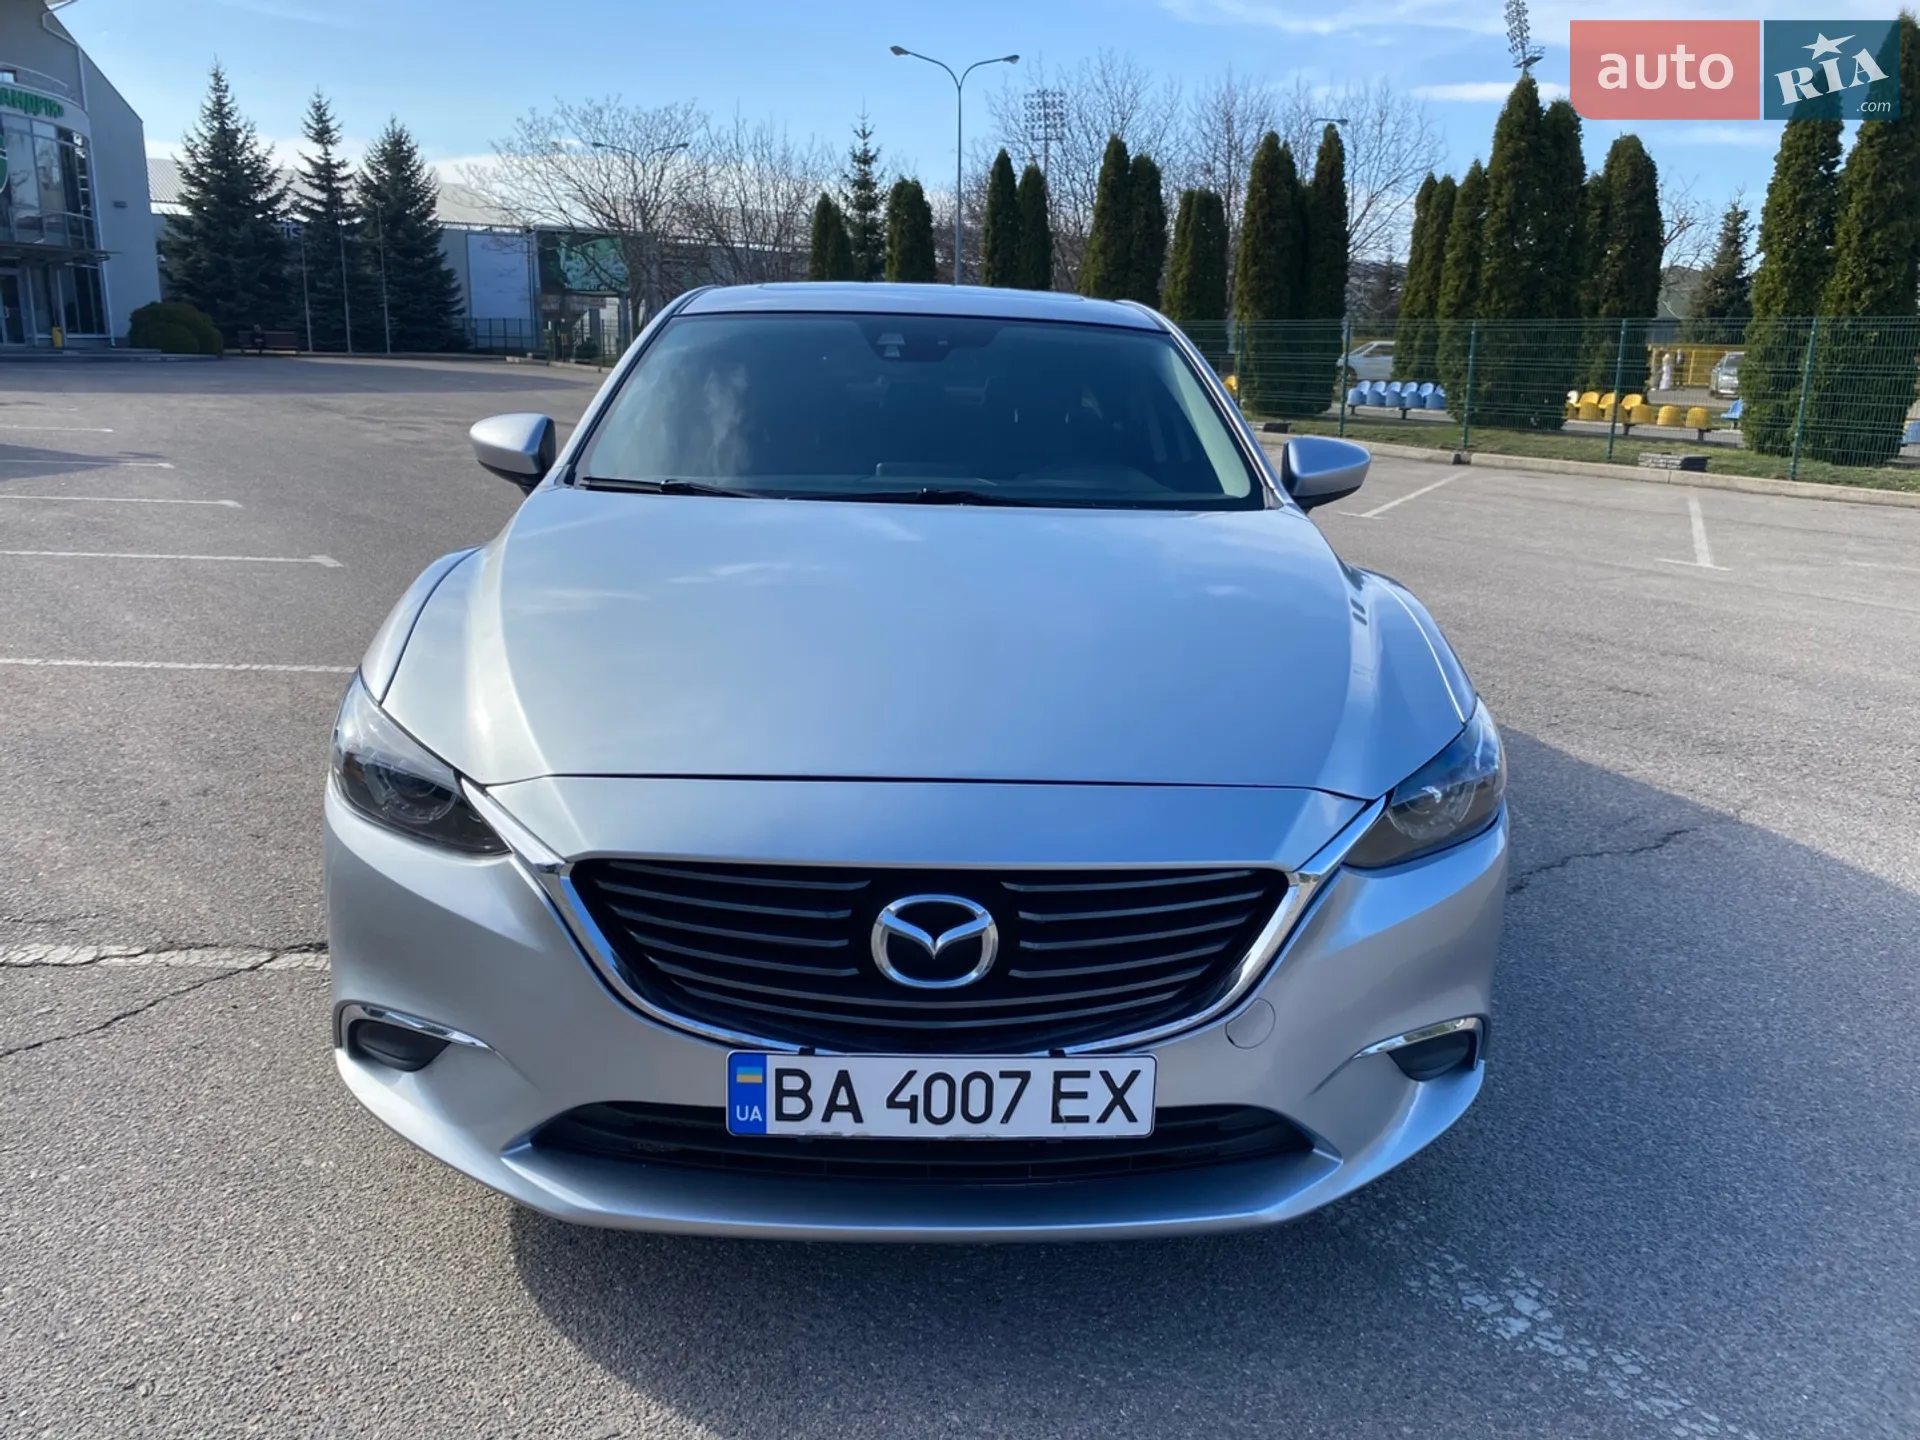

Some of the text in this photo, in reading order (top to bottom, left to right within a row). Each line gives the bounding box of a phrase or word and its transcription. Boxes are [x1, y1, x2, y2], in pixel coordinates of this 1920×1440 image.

[735, 1105, 763, 1123] UA
[774, 1067, 1142, 1125] BA 4007 EX
